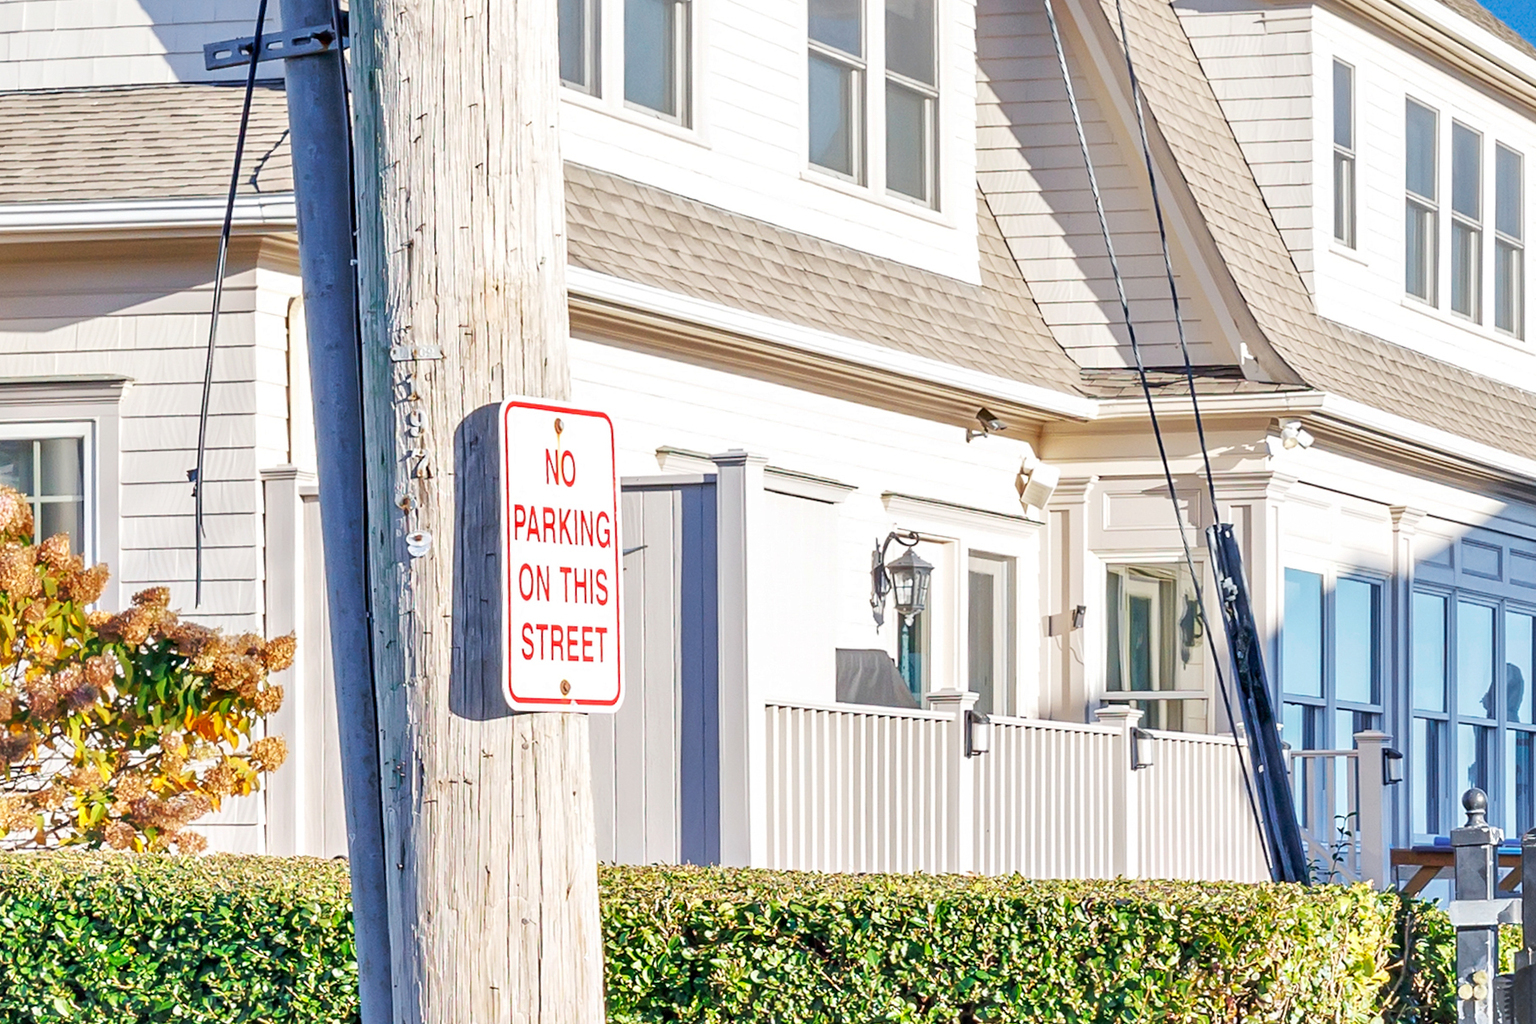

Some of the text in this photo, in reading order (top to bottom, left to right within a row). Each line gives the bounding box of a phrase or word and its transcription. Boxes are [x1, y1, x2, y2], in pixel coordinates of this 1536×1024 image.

[545, 448, 575, 487] NO
[514, 504, 611, 548] PARKING
[519, 563, 608, 606] ON THIS
[521, 622, 608, 663] STREET
